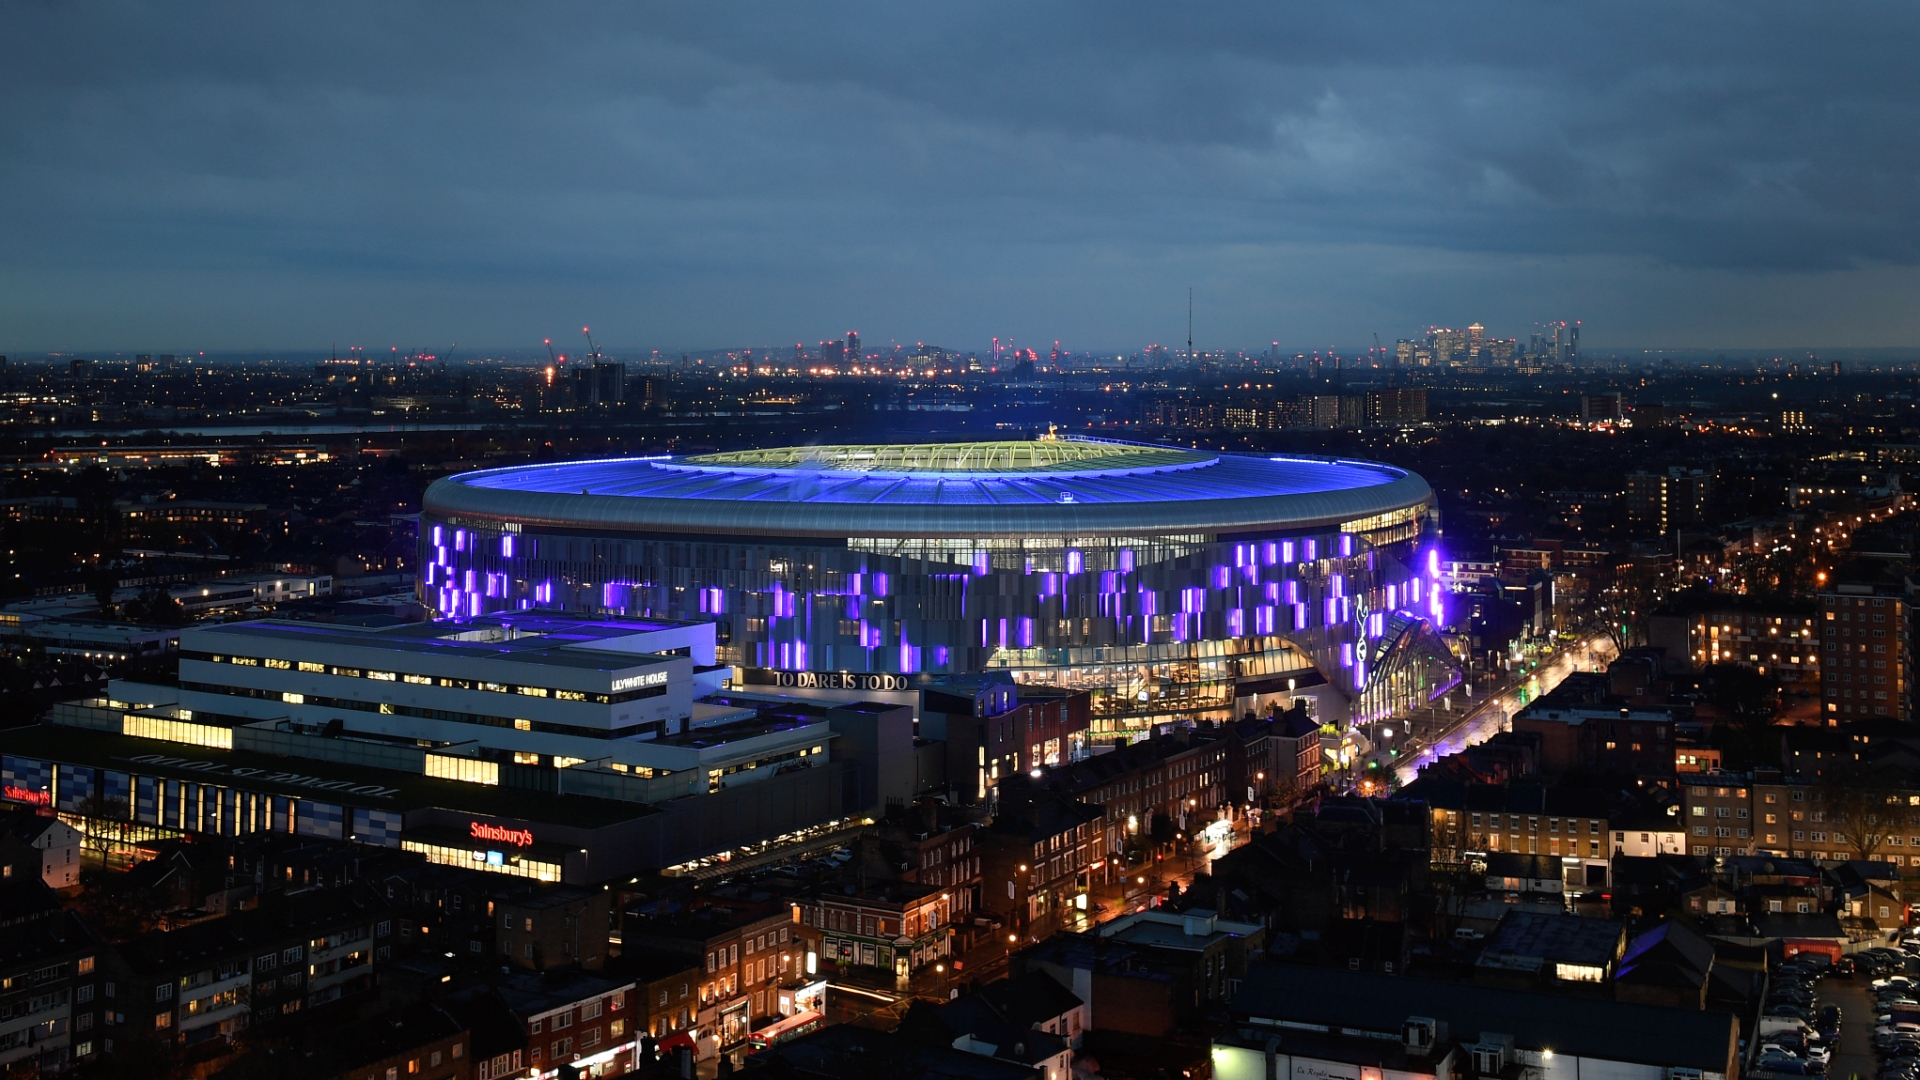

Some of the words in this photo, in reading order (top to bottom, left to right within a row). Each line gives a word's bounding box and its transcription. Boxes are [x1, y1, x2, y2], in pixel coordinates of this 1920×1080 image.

[611, 675, 645, 691] LILYWHITE
[646, 671, 668, 685] HOUSE
[774, 671, 794, 687] TO
[797, 672, 838, 688] DARE
[842, 673, 856, 689] IS
[860, 674, 880, 690] TO
[883, 674, 908, 690] DO
[4, 785, 50, 805] Sainsbury's
[470, 822, 533, 847] Sainsbury's
